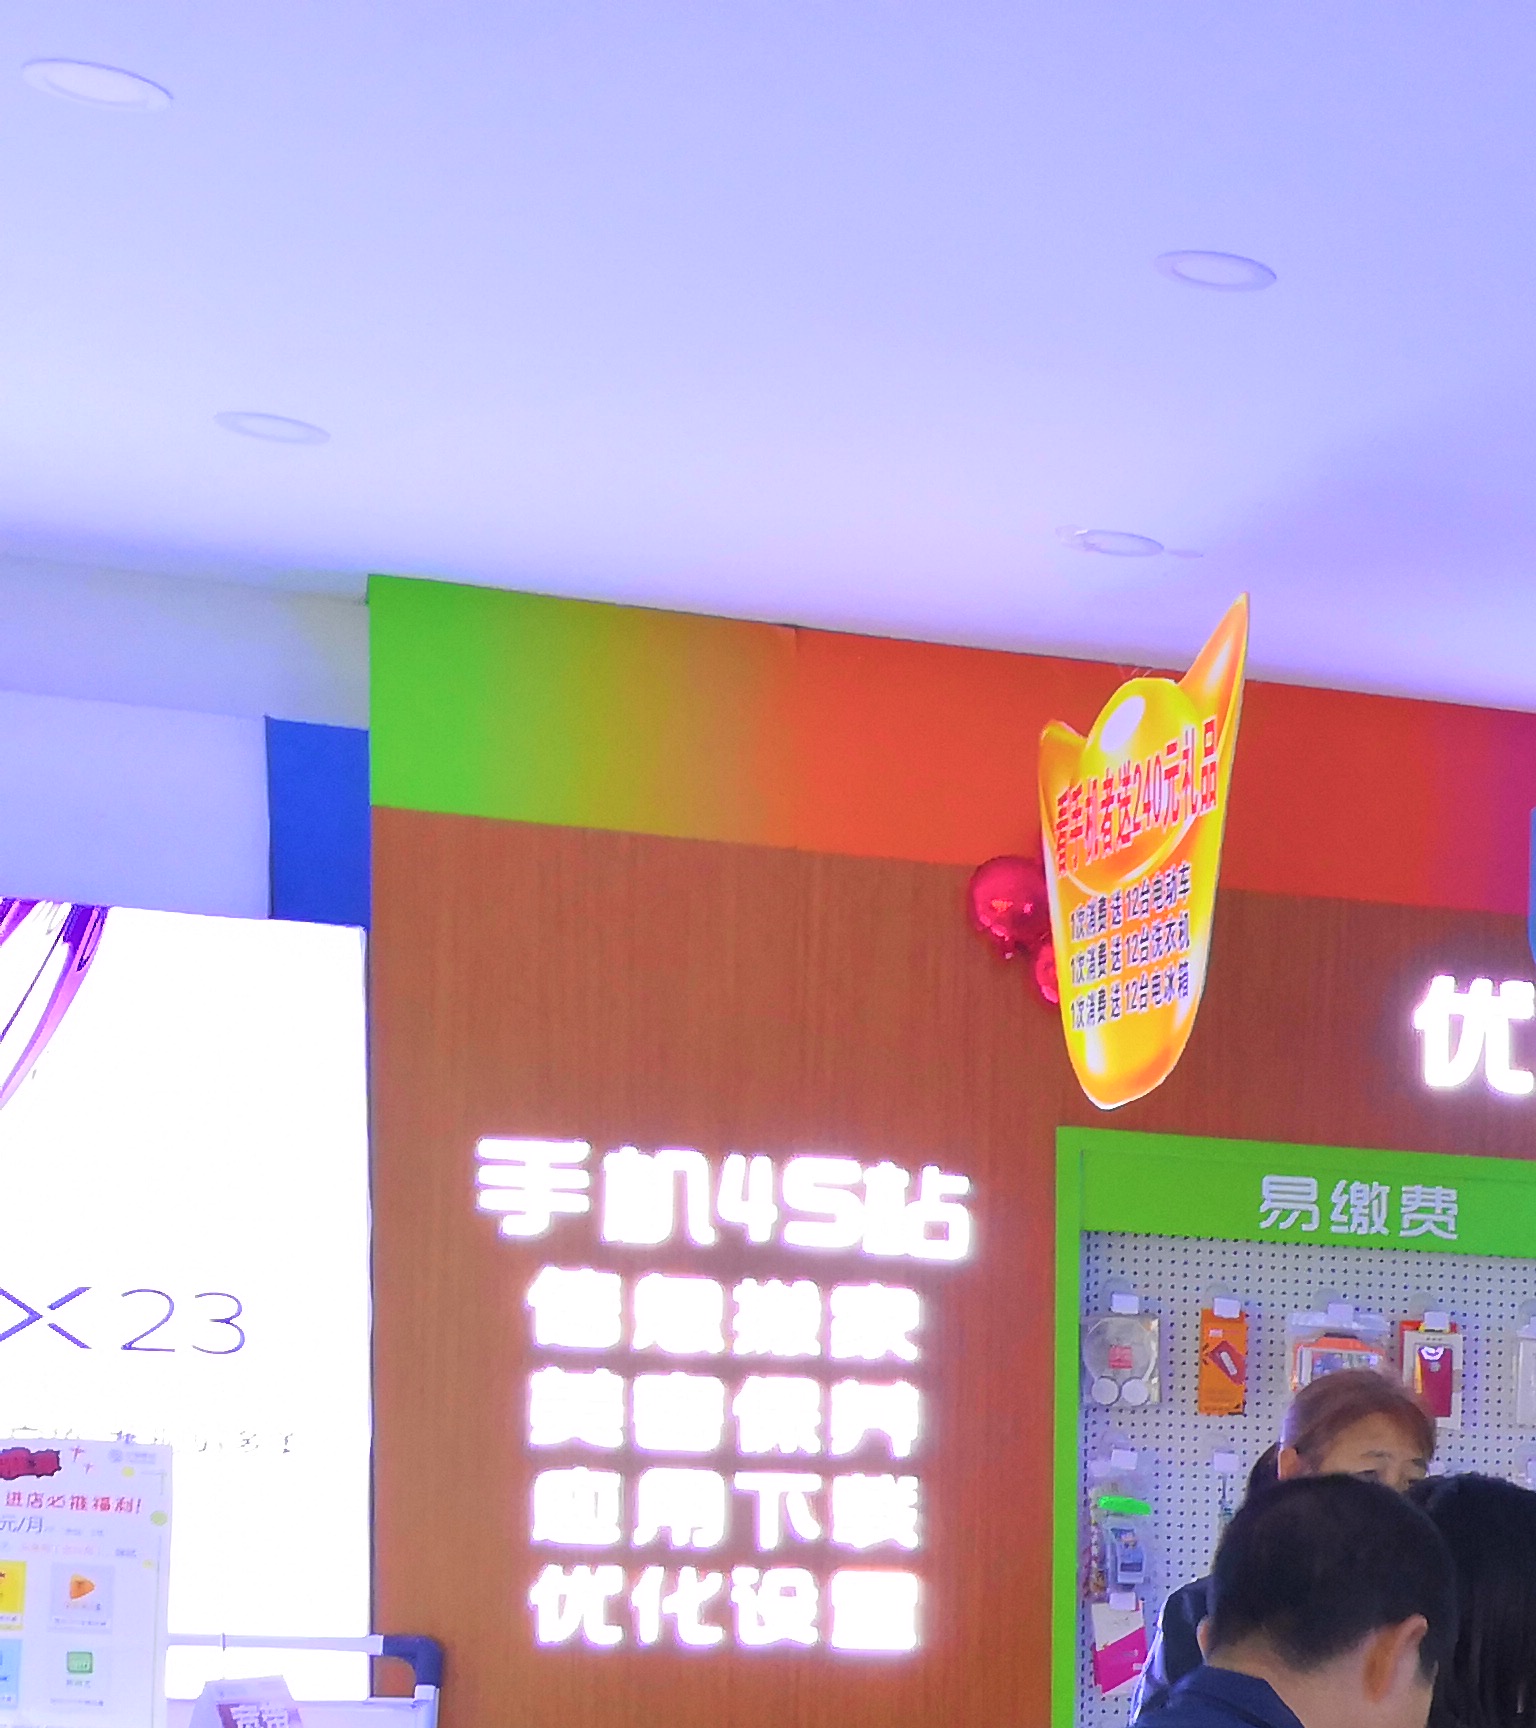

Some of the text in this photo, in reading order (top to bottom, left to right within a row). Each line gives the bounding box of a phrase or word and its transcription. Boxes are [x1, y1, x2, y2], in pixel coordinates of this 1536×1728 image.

[475, 1135, 974, 1262] 手机4S站
[1259, 1174, 1459, 1240] 易缴费
